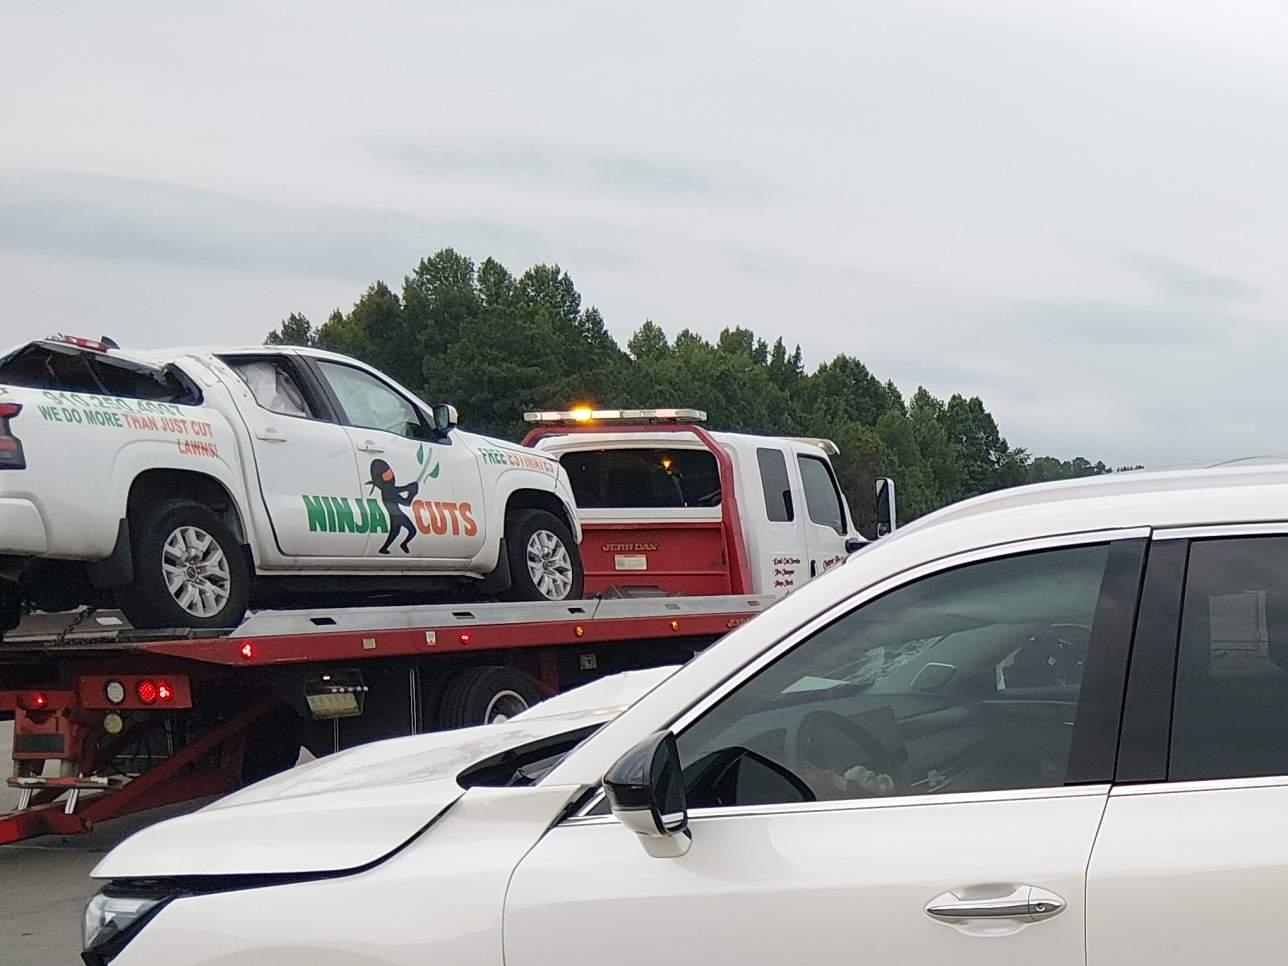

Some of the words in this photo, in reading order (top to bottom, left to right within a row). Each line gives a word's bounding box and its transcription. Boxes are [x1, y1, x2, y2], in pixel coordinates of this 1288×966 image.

[38, 405, 62, 422] WE
[62, 407, 82, 424] DO
[85, 409, 123, 428] MORE
[122, 413, 158, 432] THAN
[161, 418, 189, 435] JUST
[192, 421, 214, 437] CUT
[177, 438, 218, 458] LAWNS!
[477, 448, 508, 465] FREE
[302, 495, 389, 534] NINJA
[412, 499, 479, 536] CUTS
